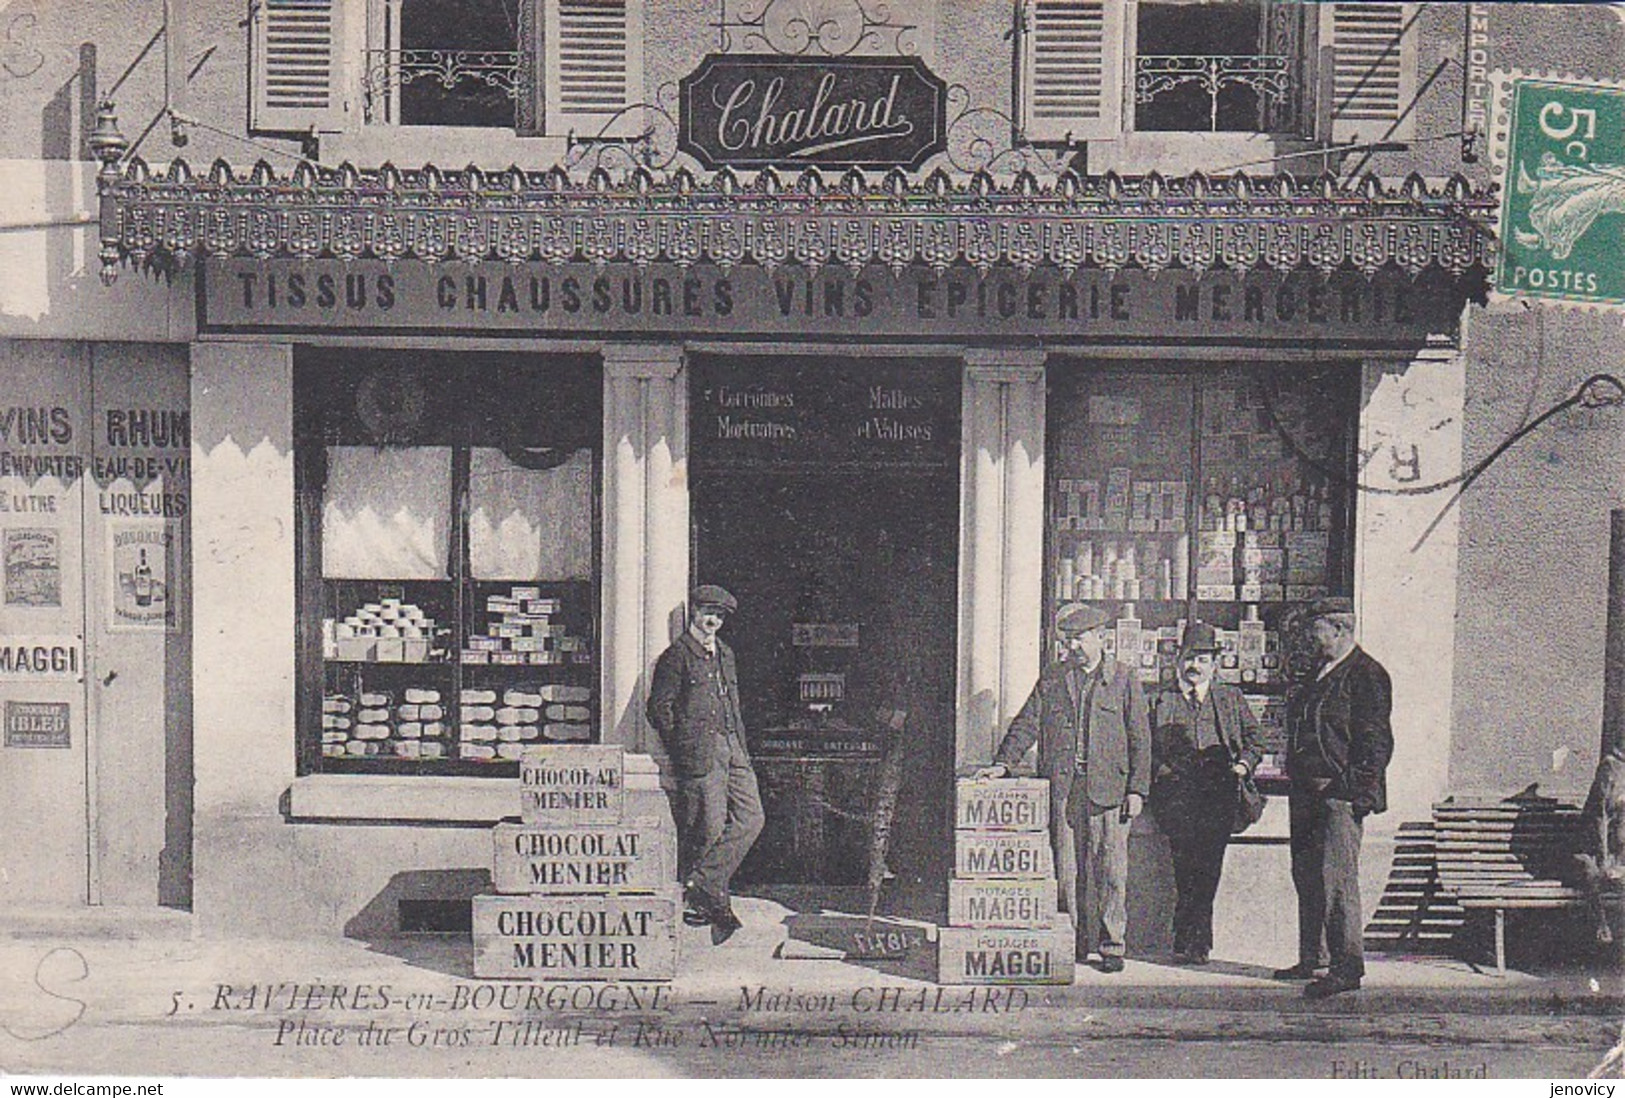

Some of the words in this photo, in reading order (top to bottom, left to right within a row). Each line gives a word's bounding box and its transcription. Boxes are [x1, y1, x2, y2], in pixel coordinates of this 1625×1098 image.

[712, 72, 907, 151] Chalard
[1514, 266, 1598, 292] POSTES
[237, 271, 397, 311] TISSUS
[436, 275, 735, 317] CHAUSSURES
[774, 279, 875, 318] VINS
[917, 281, 1131, 321] EPICERIE
[107, 409, 190, 448] RHUM
[95, 457, 191, 479] EAU-DE-VI
[14, 495, 56, 512] LITRE
[99, 493, 188, 517] LIQUEURS
[523, 767, 618, 786] CHOCOLAT
[533, 791, 608, 809] MENIER
[966, 801, 1036, 825] MAGGI
[515, 833, 640, 856] CHOCOLAT
[968, 849, 1038, 873] MAGGI
[530, 862, 629, 885] MENIER
[969, 898, 1039, 921] MAGGI
[498, 910, 652, 936] CHOCOLAT
[977, 937, 1039, 949] POTAGES
[513, 942, 639, 970] MENIER
[965, 951, 1050, 976] MAGGI
